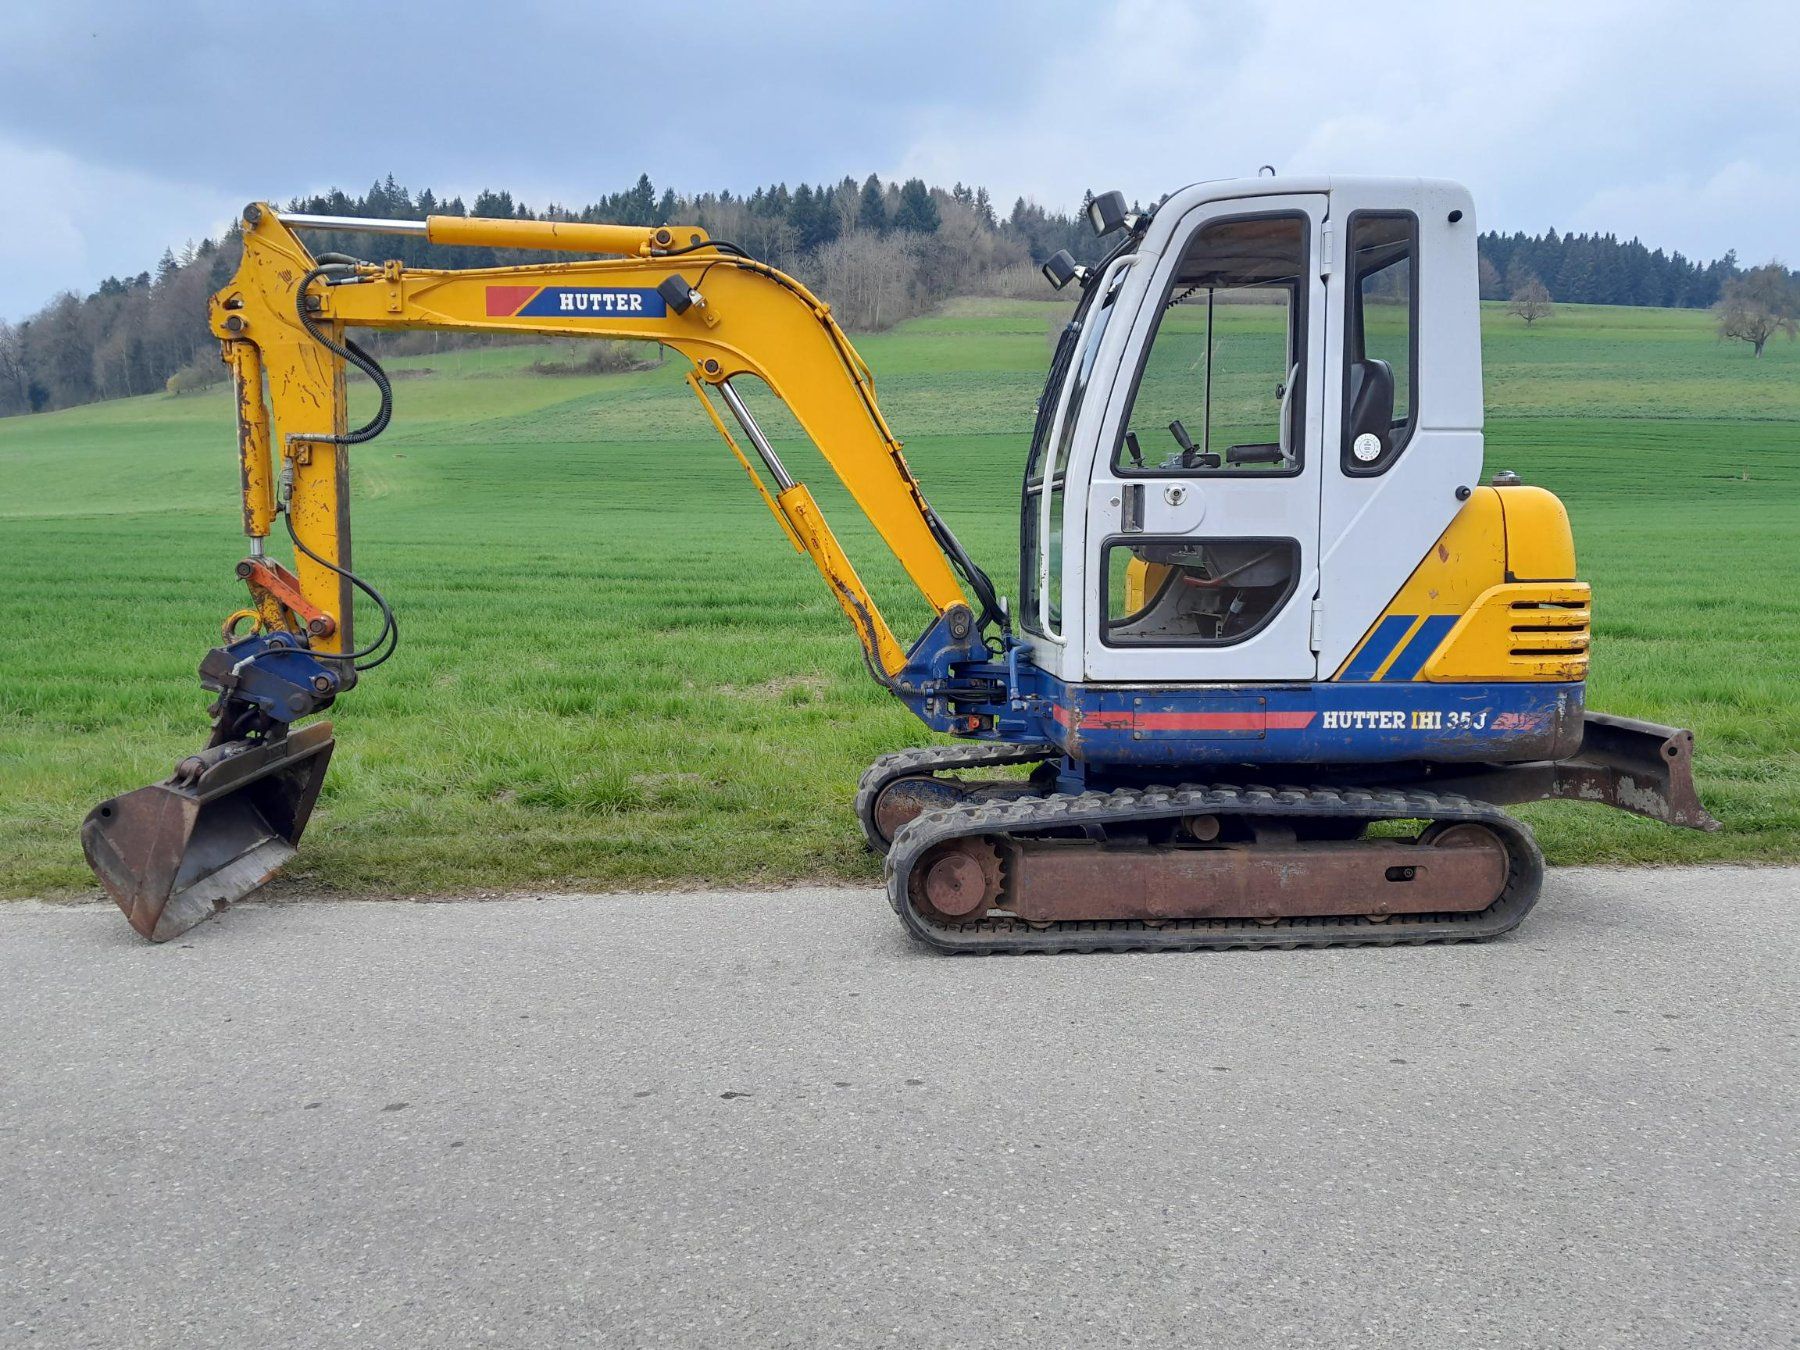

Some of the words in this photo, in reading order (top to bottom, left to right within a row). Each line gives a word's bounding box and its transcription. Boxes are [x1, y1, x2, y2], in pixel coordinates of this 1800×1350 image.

[559, 293, 642, 311] HUTTER
[1322, 711, 1405, 729] HUTTER
[1411, 711, 1442, 729] IHI
[1447, 711, 1487, 730] 35J
